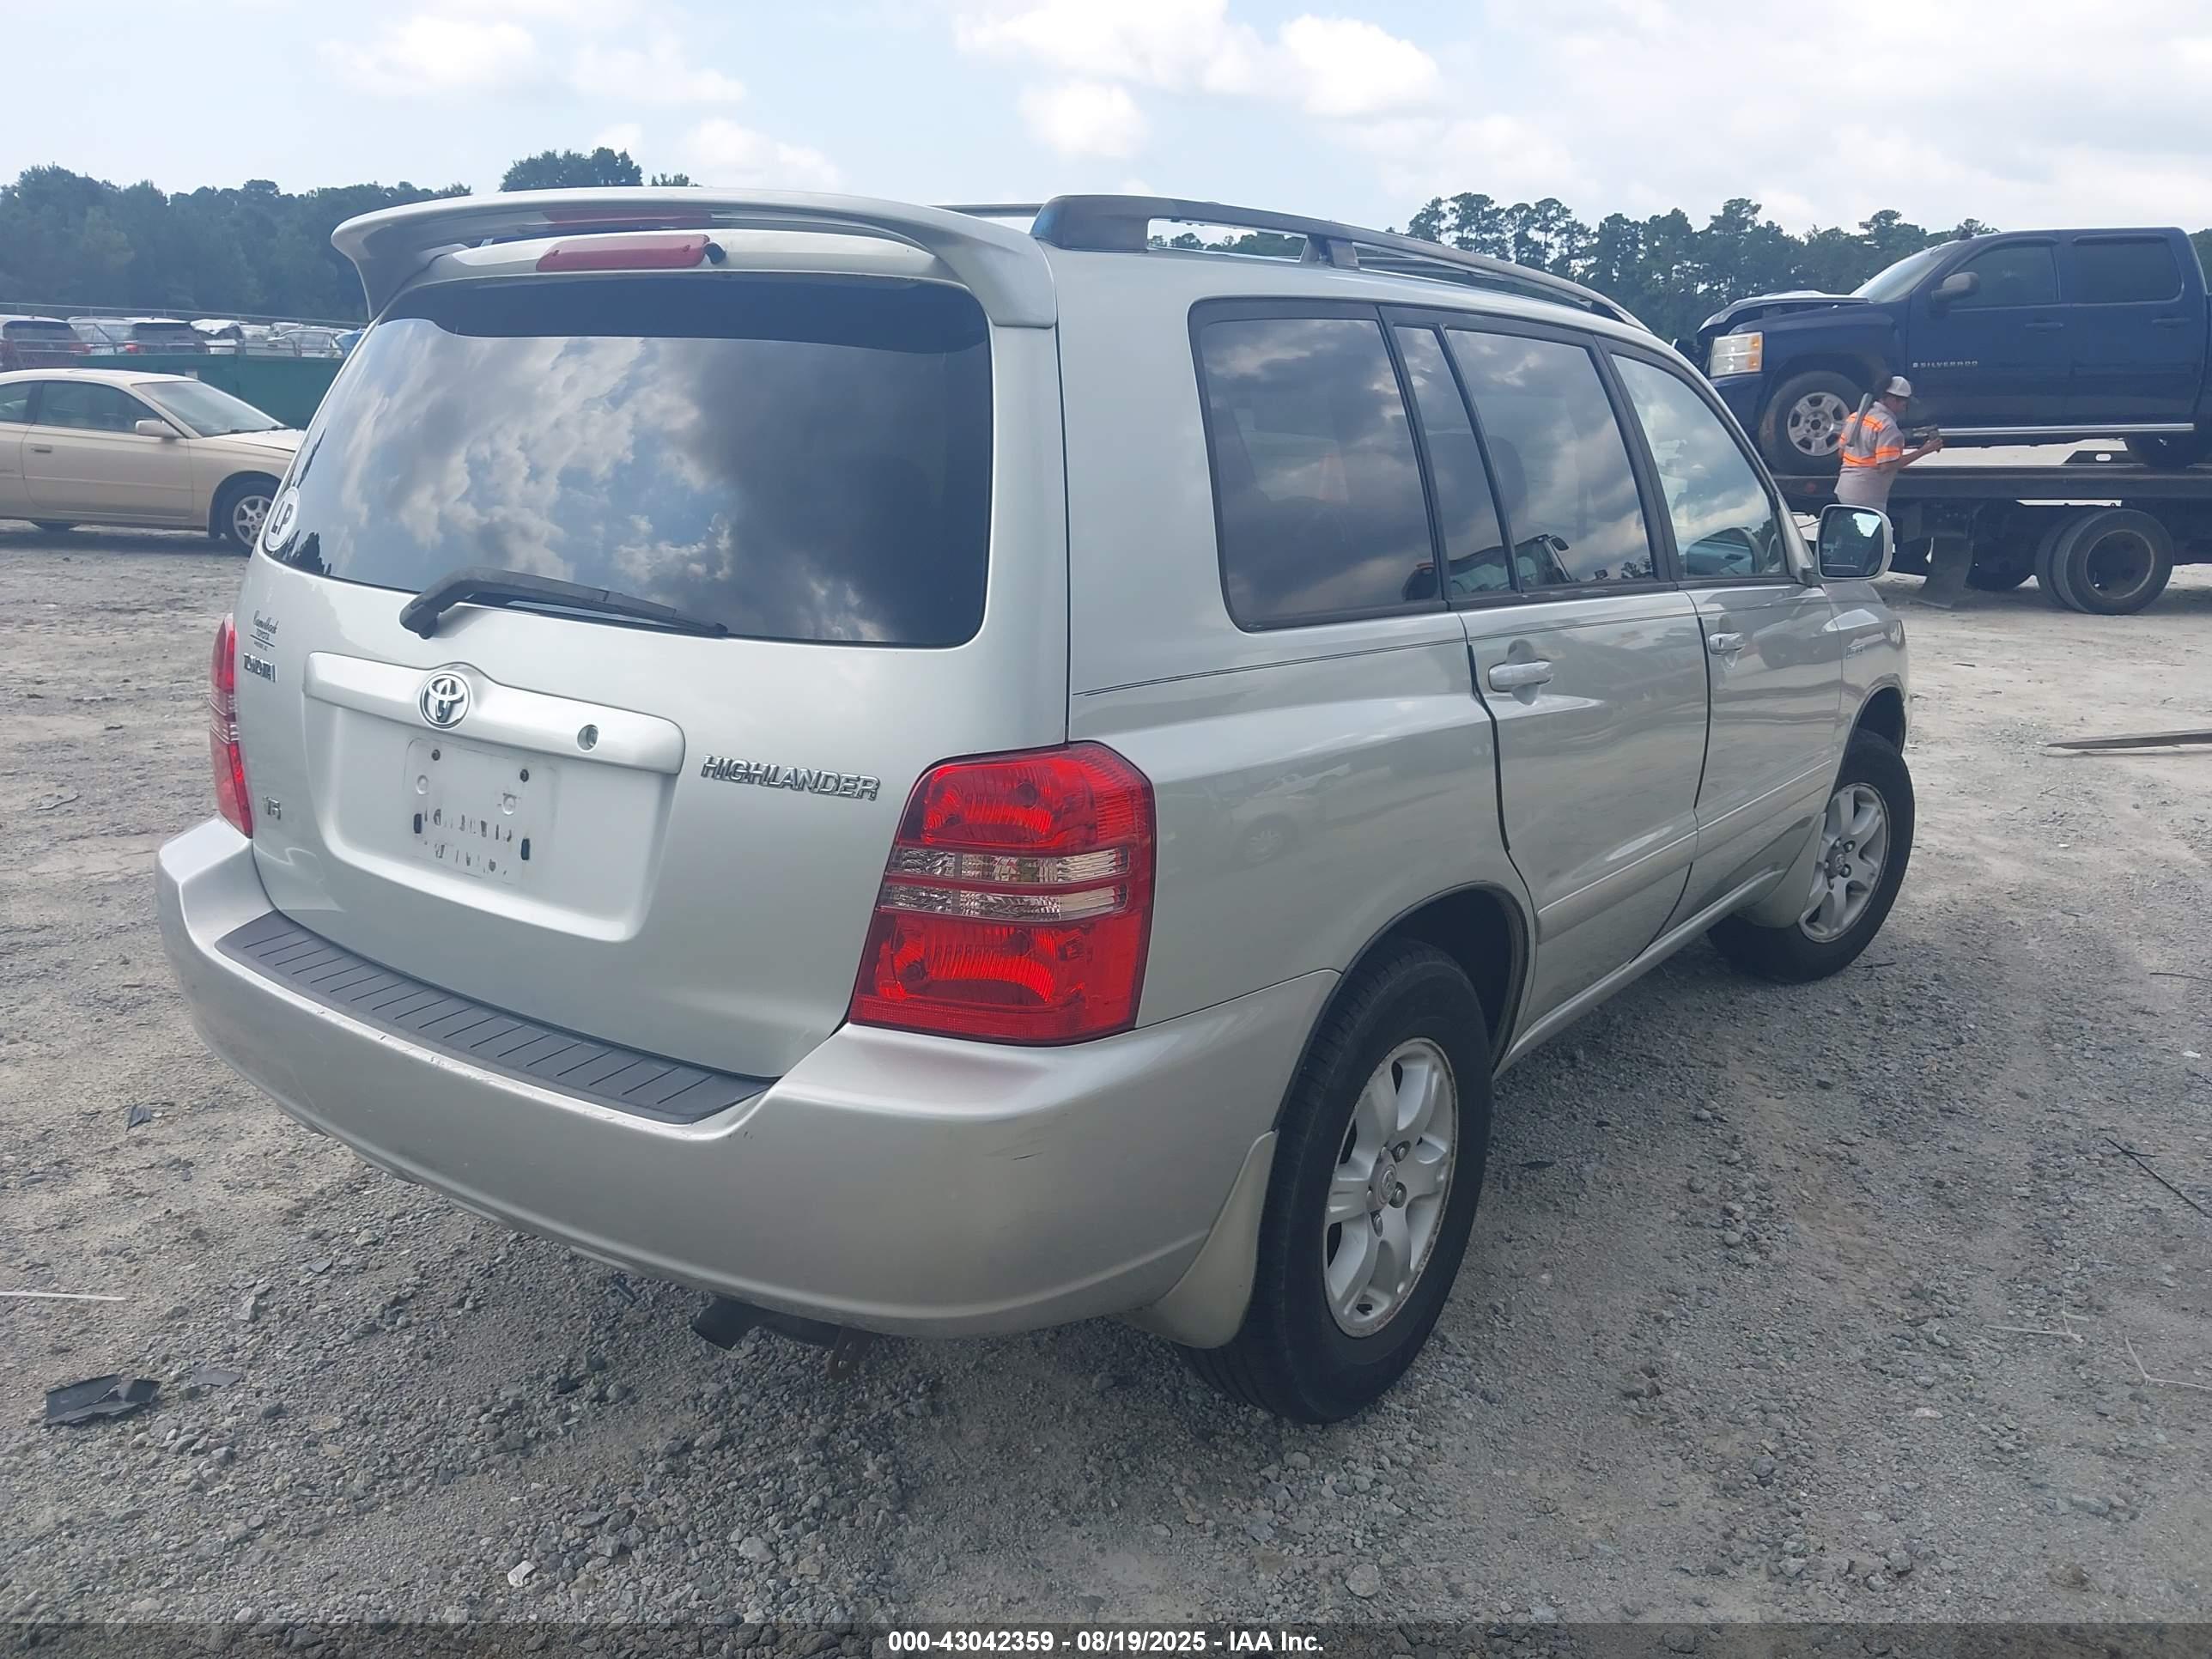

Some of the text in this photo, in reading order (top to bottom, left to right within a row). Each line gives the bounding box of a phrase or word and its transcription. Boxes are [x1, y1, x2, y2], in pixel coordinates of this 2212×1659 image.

[1920, 360, 1978, 368] SILVERADO
[270, 501, 294, 536] LP
[243, 653, 277, 683] TOYOTA
[701, 754, 880, 801] HIGHLANDER
